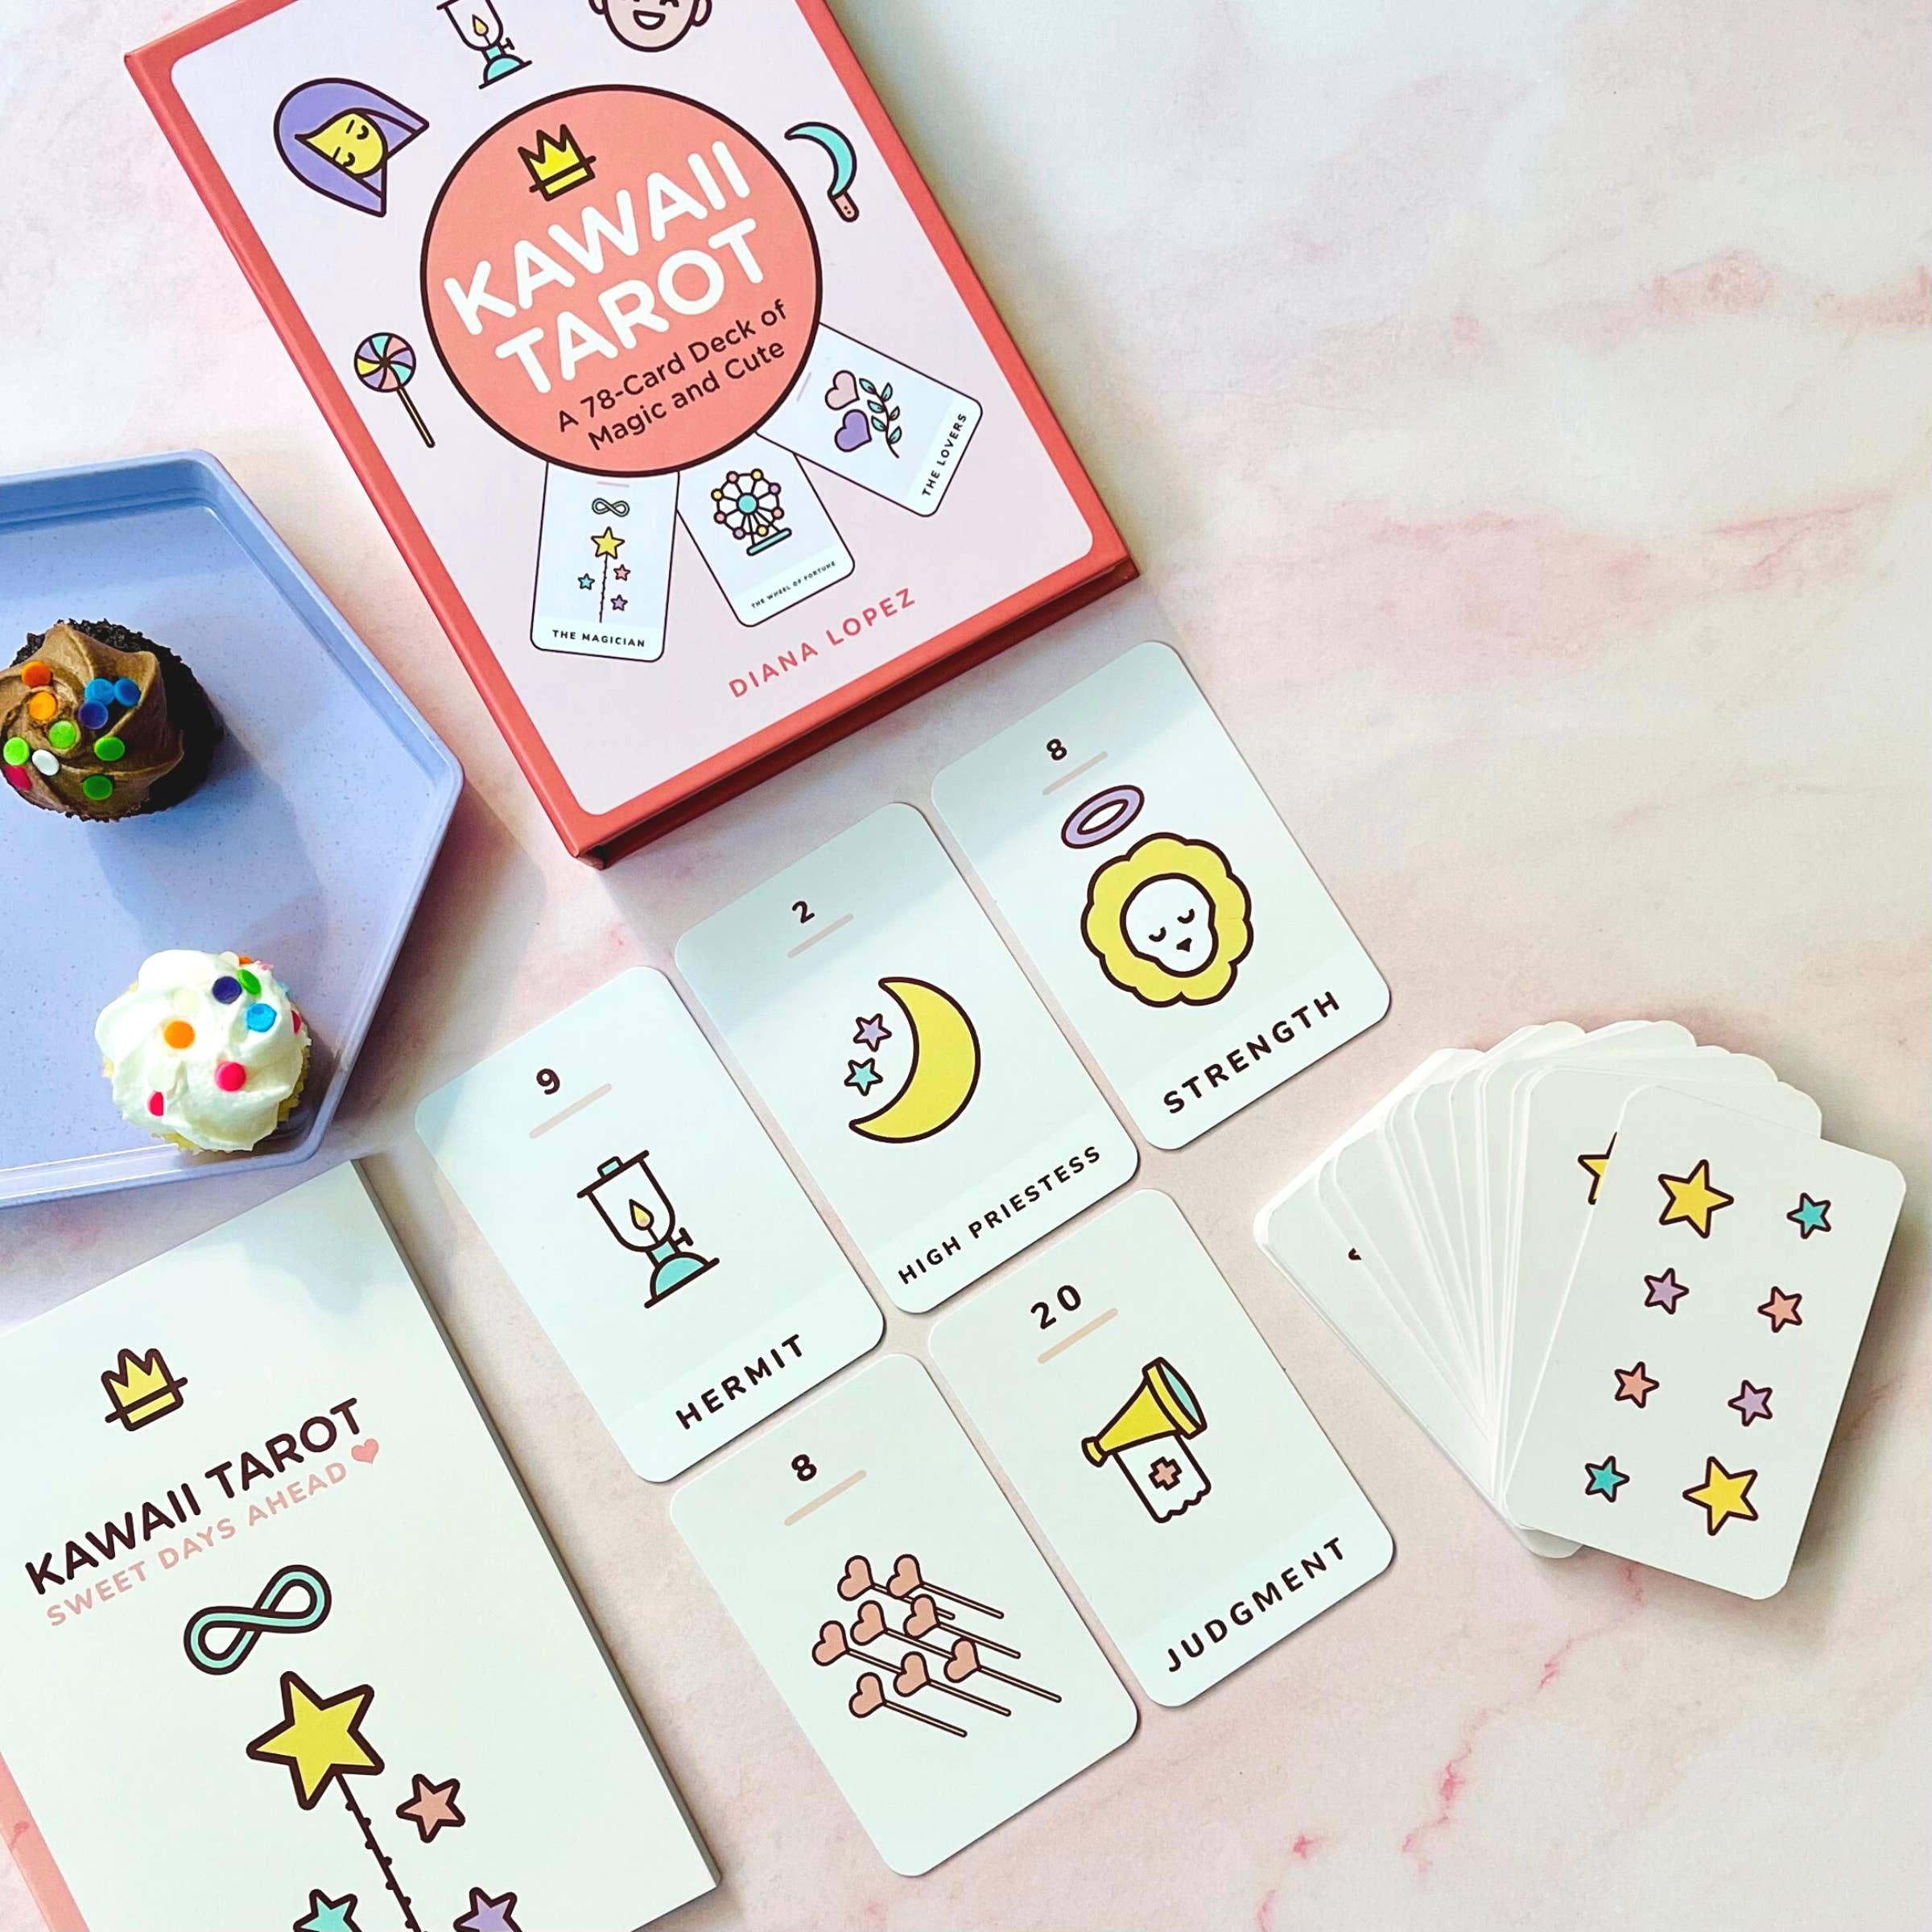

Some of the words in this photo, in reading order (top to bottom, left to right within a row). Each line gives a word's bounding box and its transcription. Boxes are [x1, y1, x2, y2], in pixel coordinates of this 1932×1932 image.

[444, 141, 750, 335] KAWAII
[495, 218, 764, 394] TAROT
[558, 410, 580, 432] A
[580, 347, 686, 419] 78-Card
[688, 317, 757, 364] Deck
[761, 299, 787, 331] of
[588, 399, 667, 451] Magic
[674, 372, 720, 410] and
[724, 342, 786, 383] Cute
[922, 469, 939, 497] THE
[936, 413, 967, 465] LOVERS
[551, 629, 578, 642] THE
[582, 632, 646, 648] MAGICIAN
[751, 599, 766, 609] THE
[766, 585, 791, 600] WHEEL
[793, 579, 802, 587] OF
[803, 560, 836, 580] FORTUNE
[729, 642, 819, 698] DIANA
[825, 587, 916, 646] LOPEZ
[1046, 738, 1067, 762] 8
[792, 900, 815, 923] 2
[536, 1067, 560, 1096] 9
[1163, 990, 1340, 1115] STRENGTH
[898, 1236, 961, 1285] HIGH
[968, 1146, 1101, 1239] PRIESTESS
[1030, 1285, 1082, 1330] 20
[675, 1333, 803, 1430] HERMIT
[25, 1483, 201, 1596] KAWAII
[204, 1397, 360, 1499] TAROT
[791, 1453, 817, 1482] 8
[46, 1560, 148, 1626] SWEET
[158, 1517, 236, 1571] DAYS
[248, 1462, 347, 1526] AHEAD
[1168, 1537, 1344, 1673] JUDGMENT
